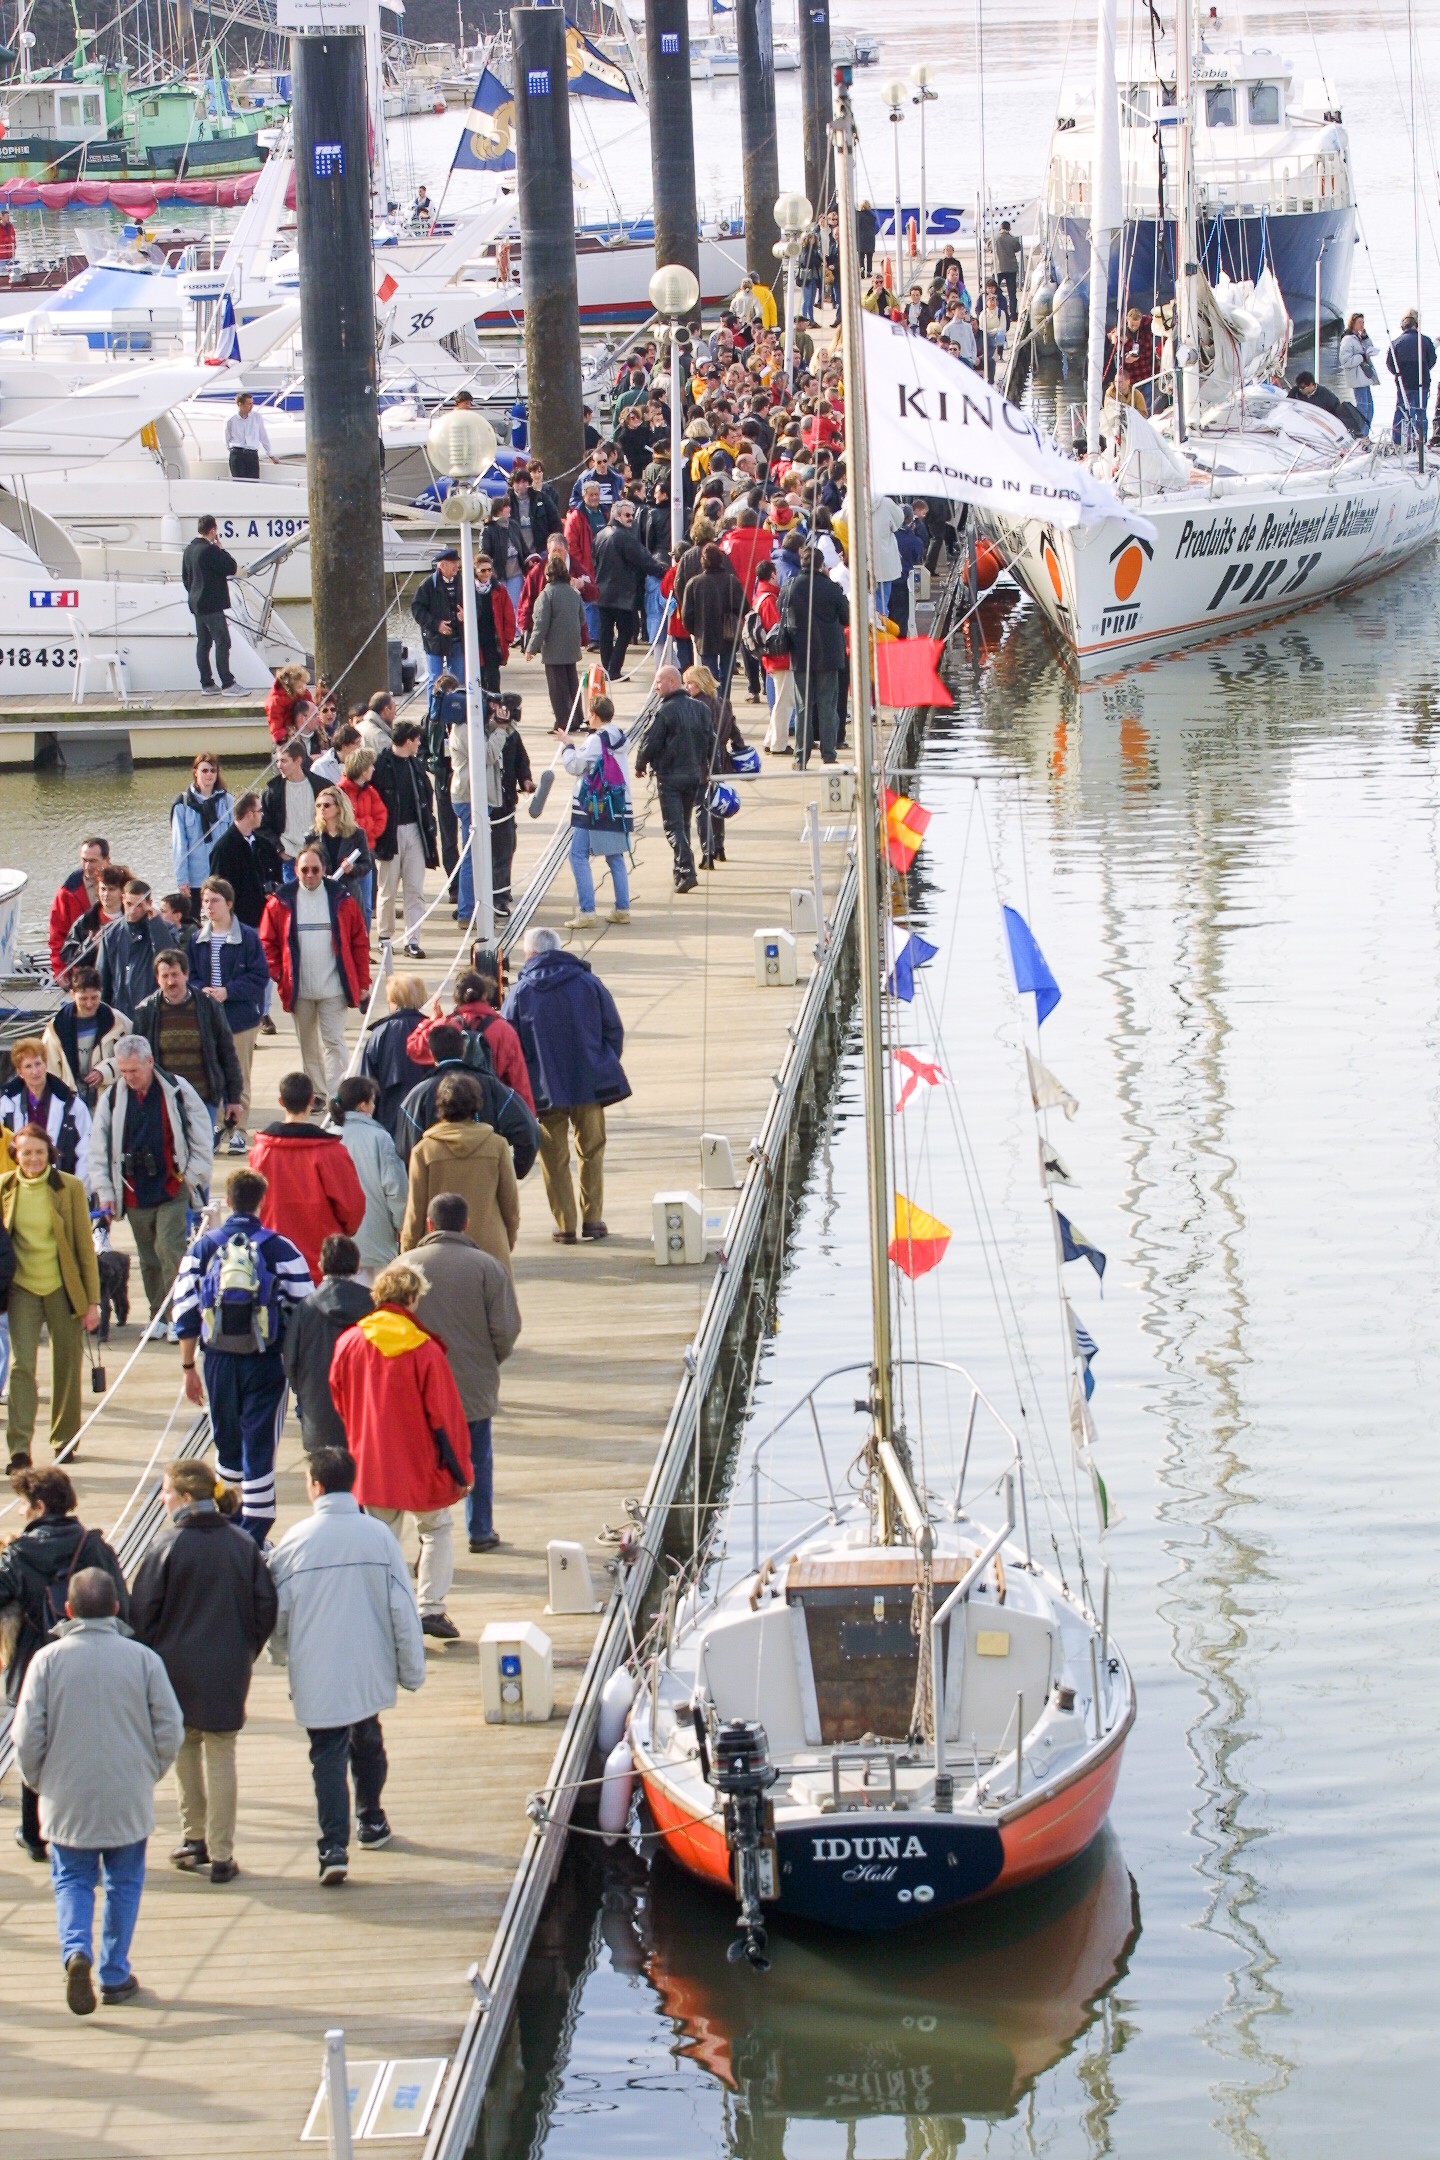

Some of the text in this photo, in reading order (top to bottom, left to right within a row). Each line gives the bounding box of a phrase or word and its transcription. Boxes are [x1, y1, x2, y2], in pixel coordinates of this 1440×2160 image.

[408, 307, 438, 337] 36
[902, 461, 993, 488] LEADING
[1002, 479, 1020, 493] IN
[1175, 516, 1237, 560] Produits
[1236, 513, 1257, 553] de
[1206, 552, 1323, 611] PRB
[1101, 612, 1139, 636] PRB
[0, 647, 78, 668] 18433
[811, 1835, 928, 1861] IDUNA
[842, 1864, 898, 1882] Hull
